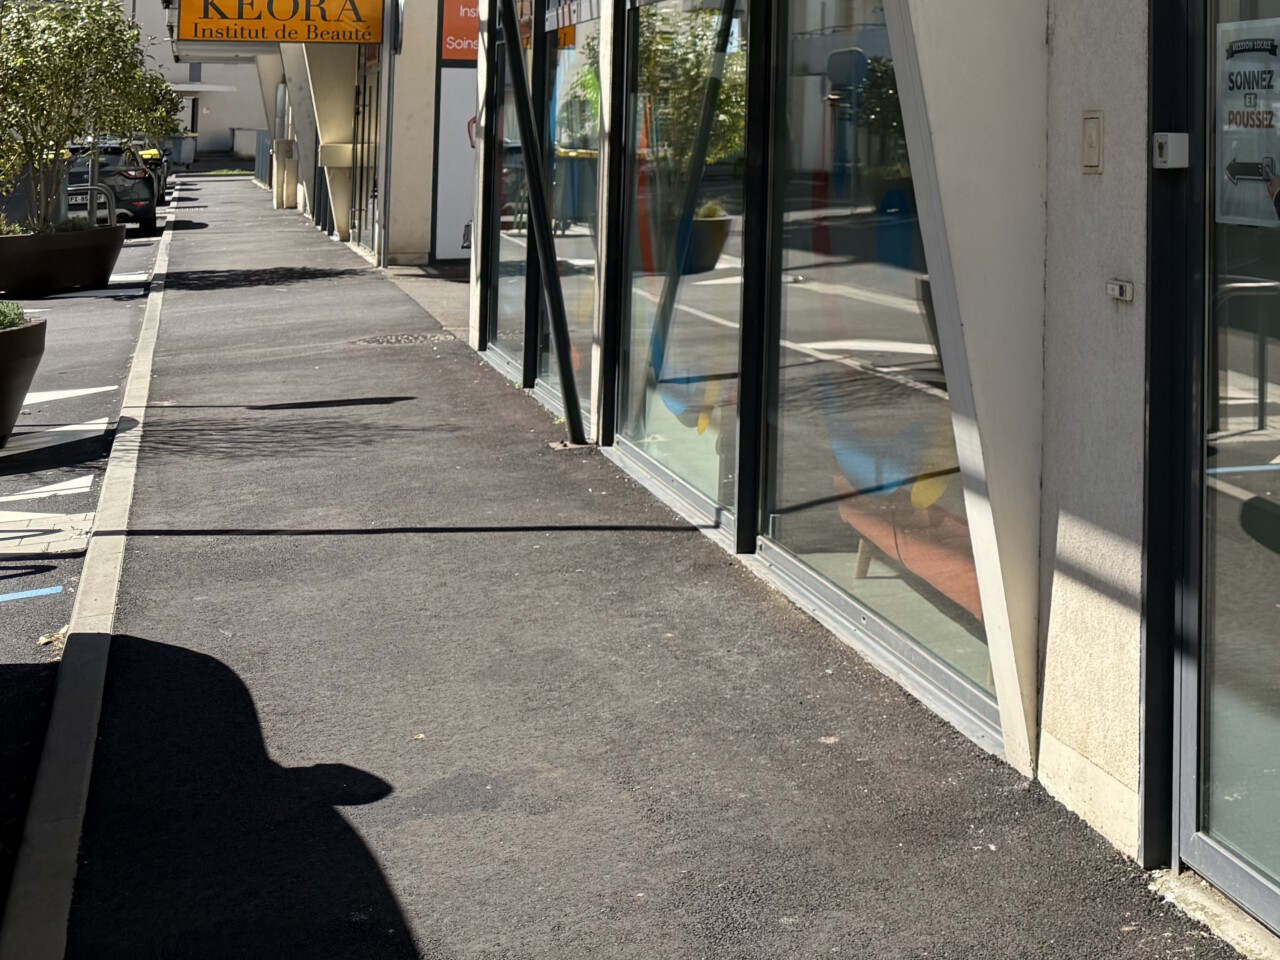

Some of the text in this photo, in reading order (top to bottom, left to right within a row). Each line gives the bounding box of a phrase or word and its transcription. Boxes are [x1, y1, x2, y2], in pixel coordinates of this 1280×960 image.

[193, 22, 372, 40] Institut de Beauté
[1232, 40, 1272, 51] MISSION LOCALE
[1228, 69, 1275, 91] SONNEZ
[1246, 95, 1256, 107] ET
[1228, 111, 1275, 129] POUSSEZ
